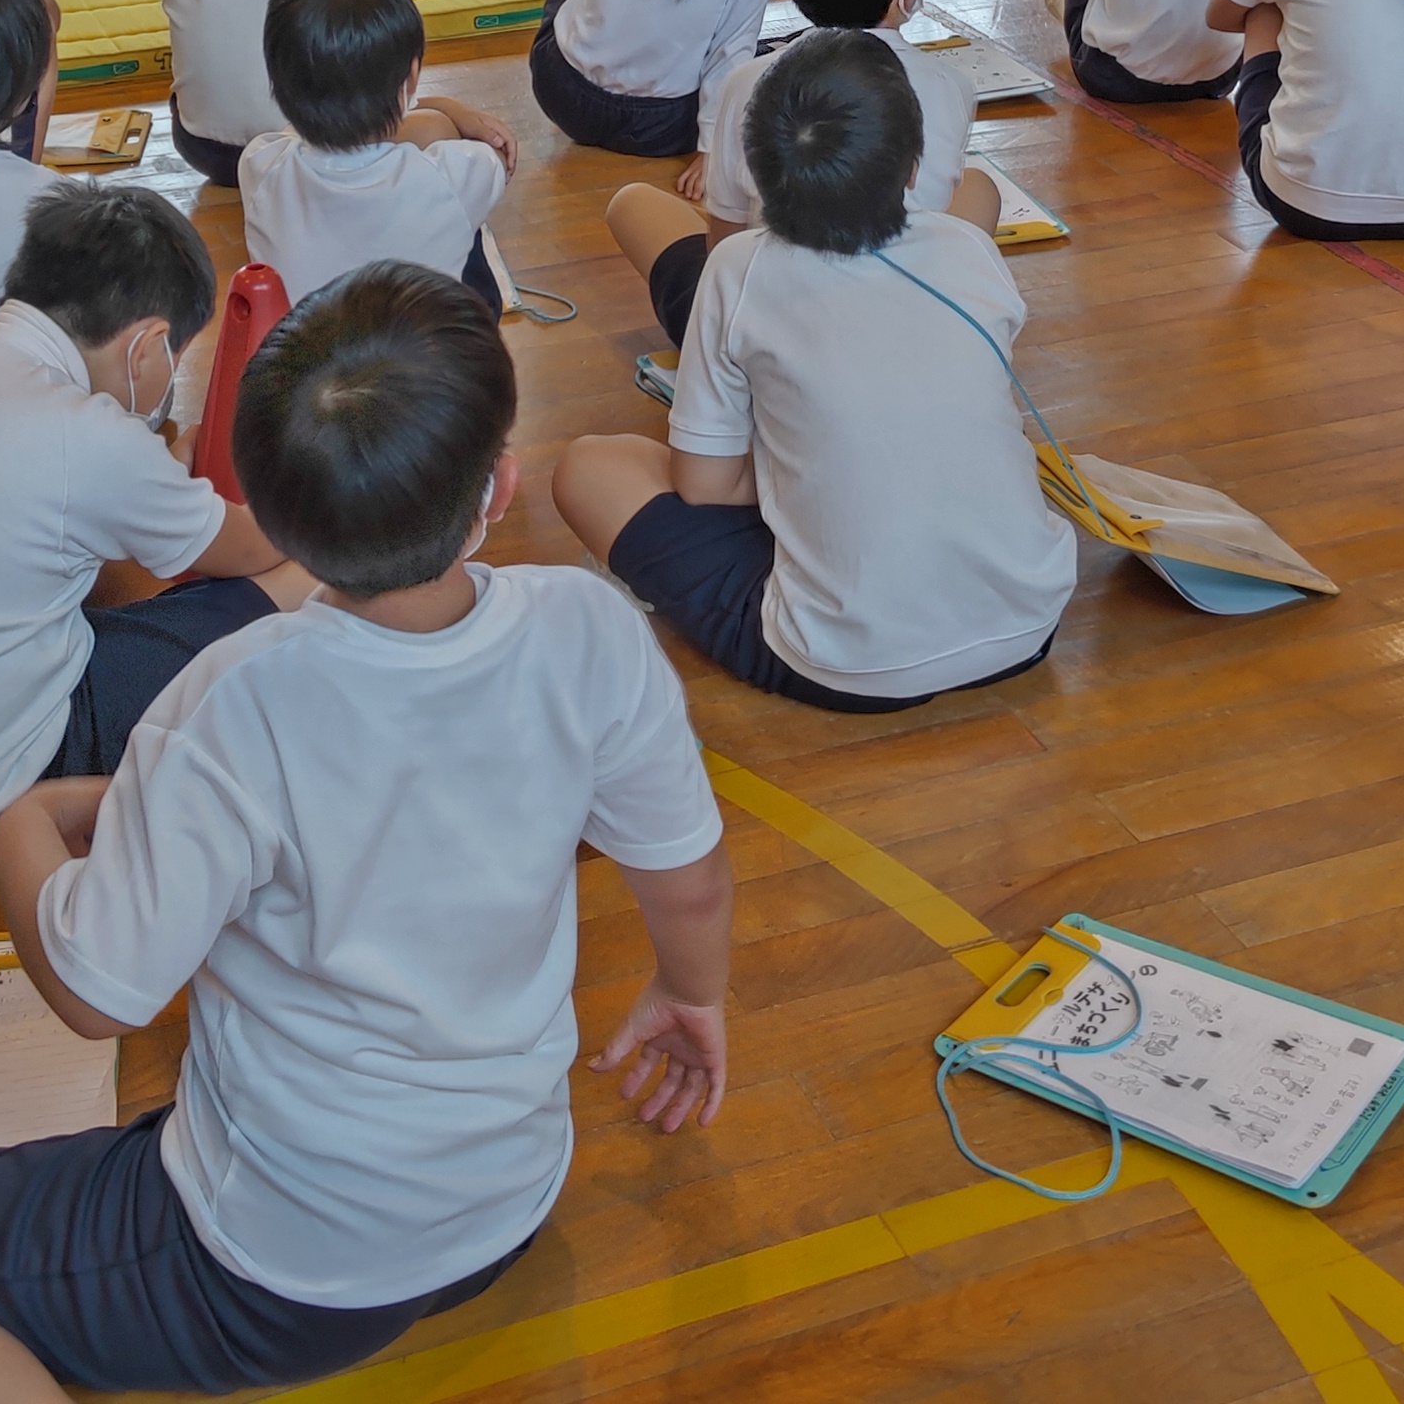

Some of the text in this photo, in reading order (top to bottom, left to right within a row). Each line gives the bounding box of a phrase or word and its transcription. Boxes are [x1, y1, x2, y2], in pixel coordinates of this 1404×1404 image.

[1069, 991, 1131, 1048] まちづくり
